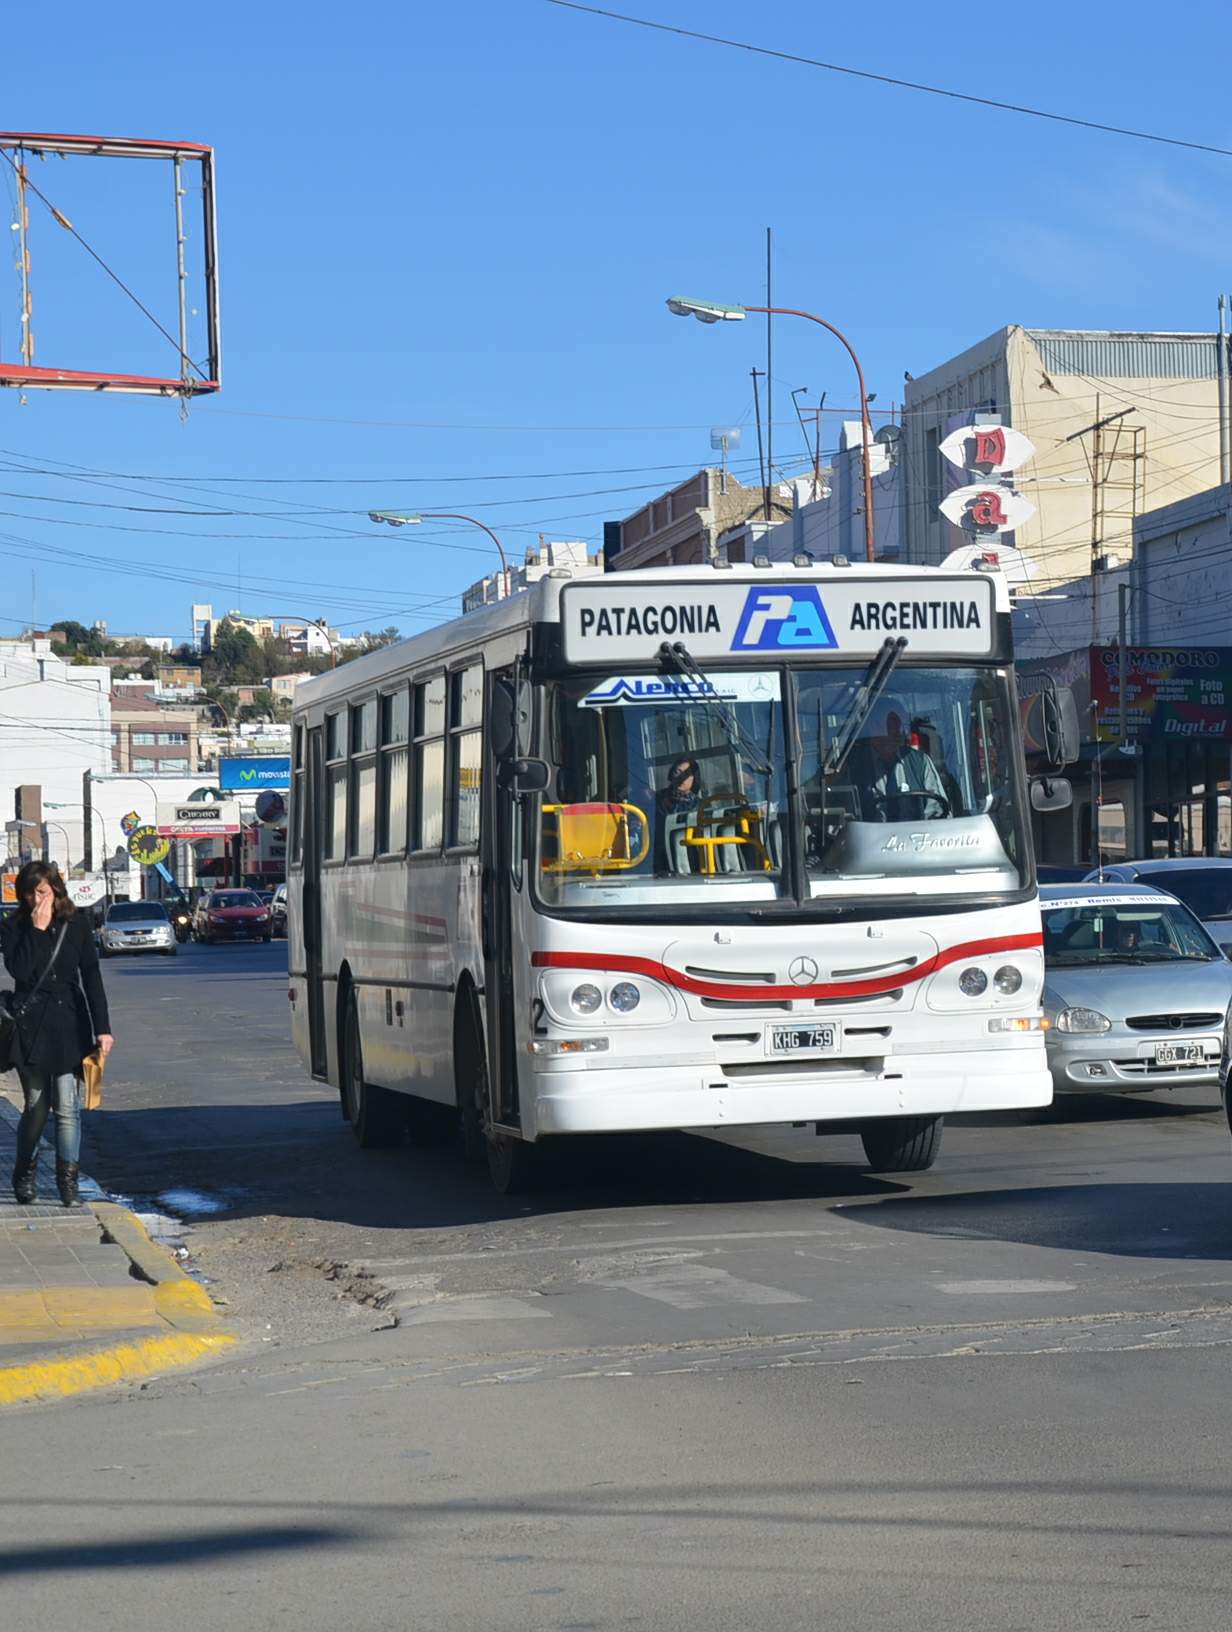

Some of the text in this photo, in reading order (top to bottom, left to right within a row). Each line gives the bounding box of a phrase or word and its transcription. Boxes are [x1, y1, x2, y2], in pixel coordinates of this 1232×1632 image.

[580, 604, 721, 637] PATAGONIA
[850, 600, 981, 631] ARGENTINA
[1200, 679, 1223, 691] Foto
[1164, 718, 1226, 737] Digital
[774, 1030, 832, 1049] KHG 759
[1158, 1046, 1202, 1061] GGX 721
